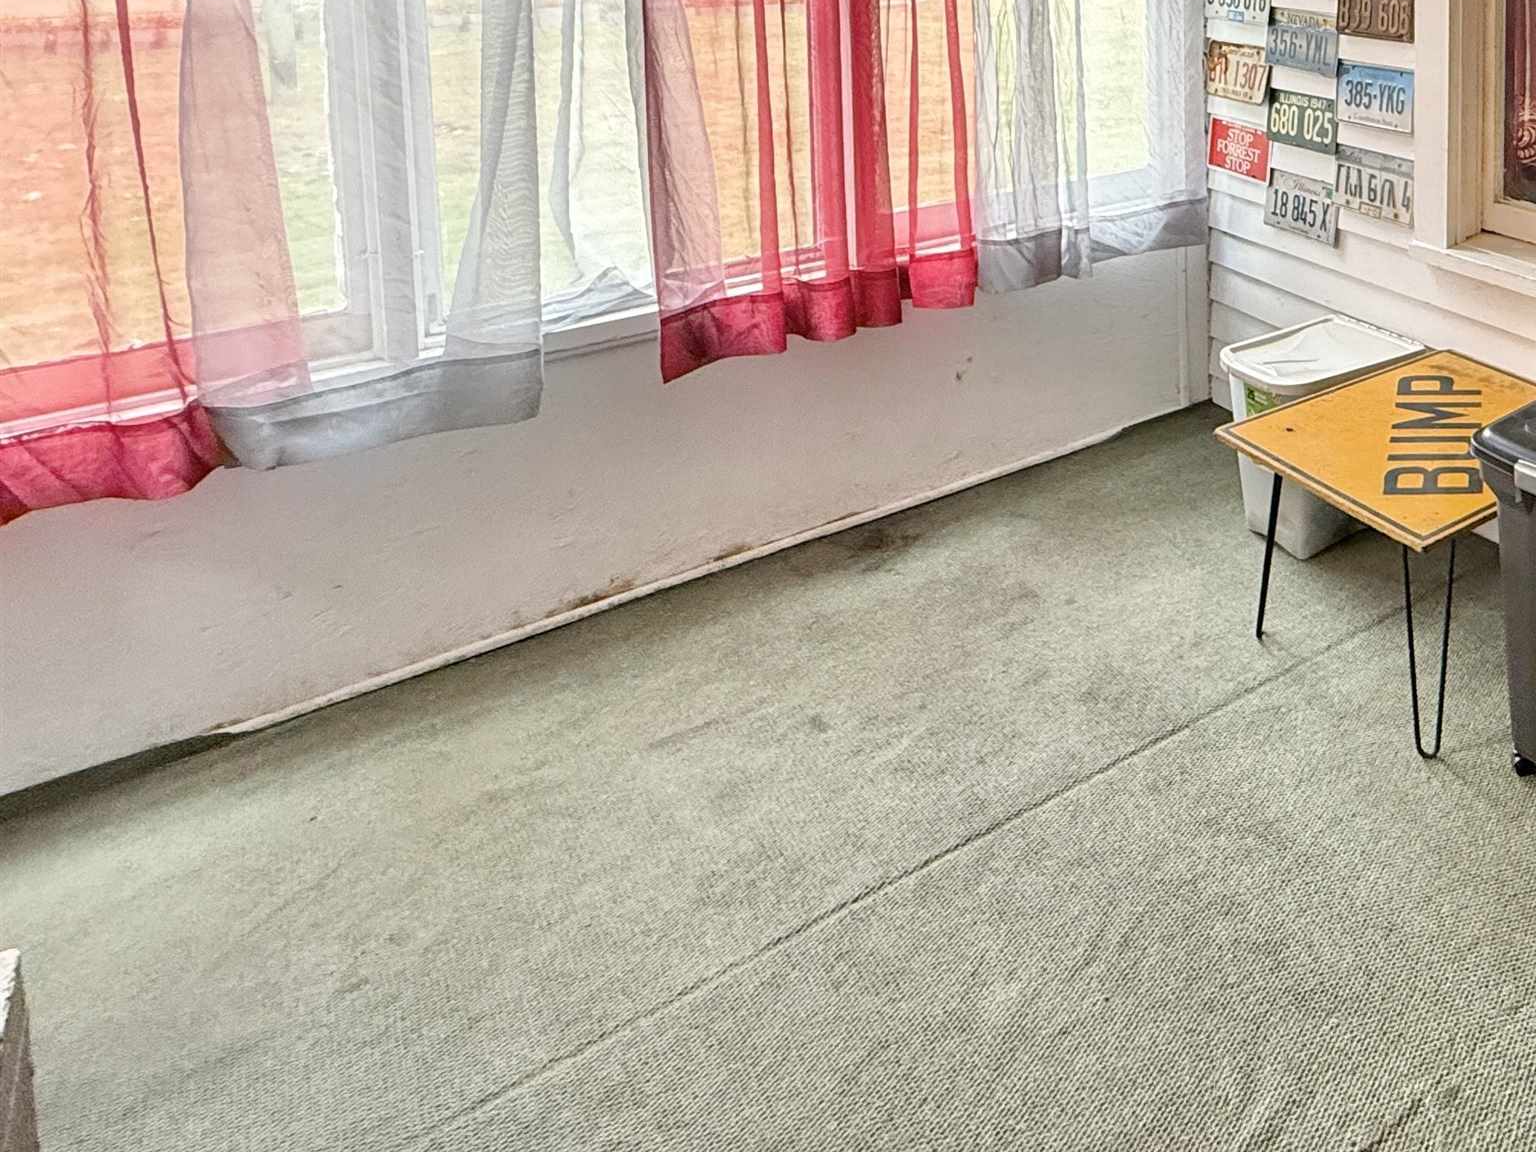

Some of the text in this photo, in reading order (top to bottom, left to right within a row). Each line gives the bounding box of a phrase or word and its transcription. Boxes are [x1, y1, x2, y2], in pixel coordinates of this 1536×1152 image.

[1234, 60, 1268, 91] 1307
[1227, 128, 1253, 148] STOP
[1271, 102, 1333, 144] 680 025
[1217, 139, 1261, 163] FORREST
[1225, 155, 1251, 174] STOP
[1271, 189, 1288, 218] 18
[1292, 194, 1318, 227] 845
[1320, 201, 1330, 232] X
[1384, 375, 1484, 495] BUMP
